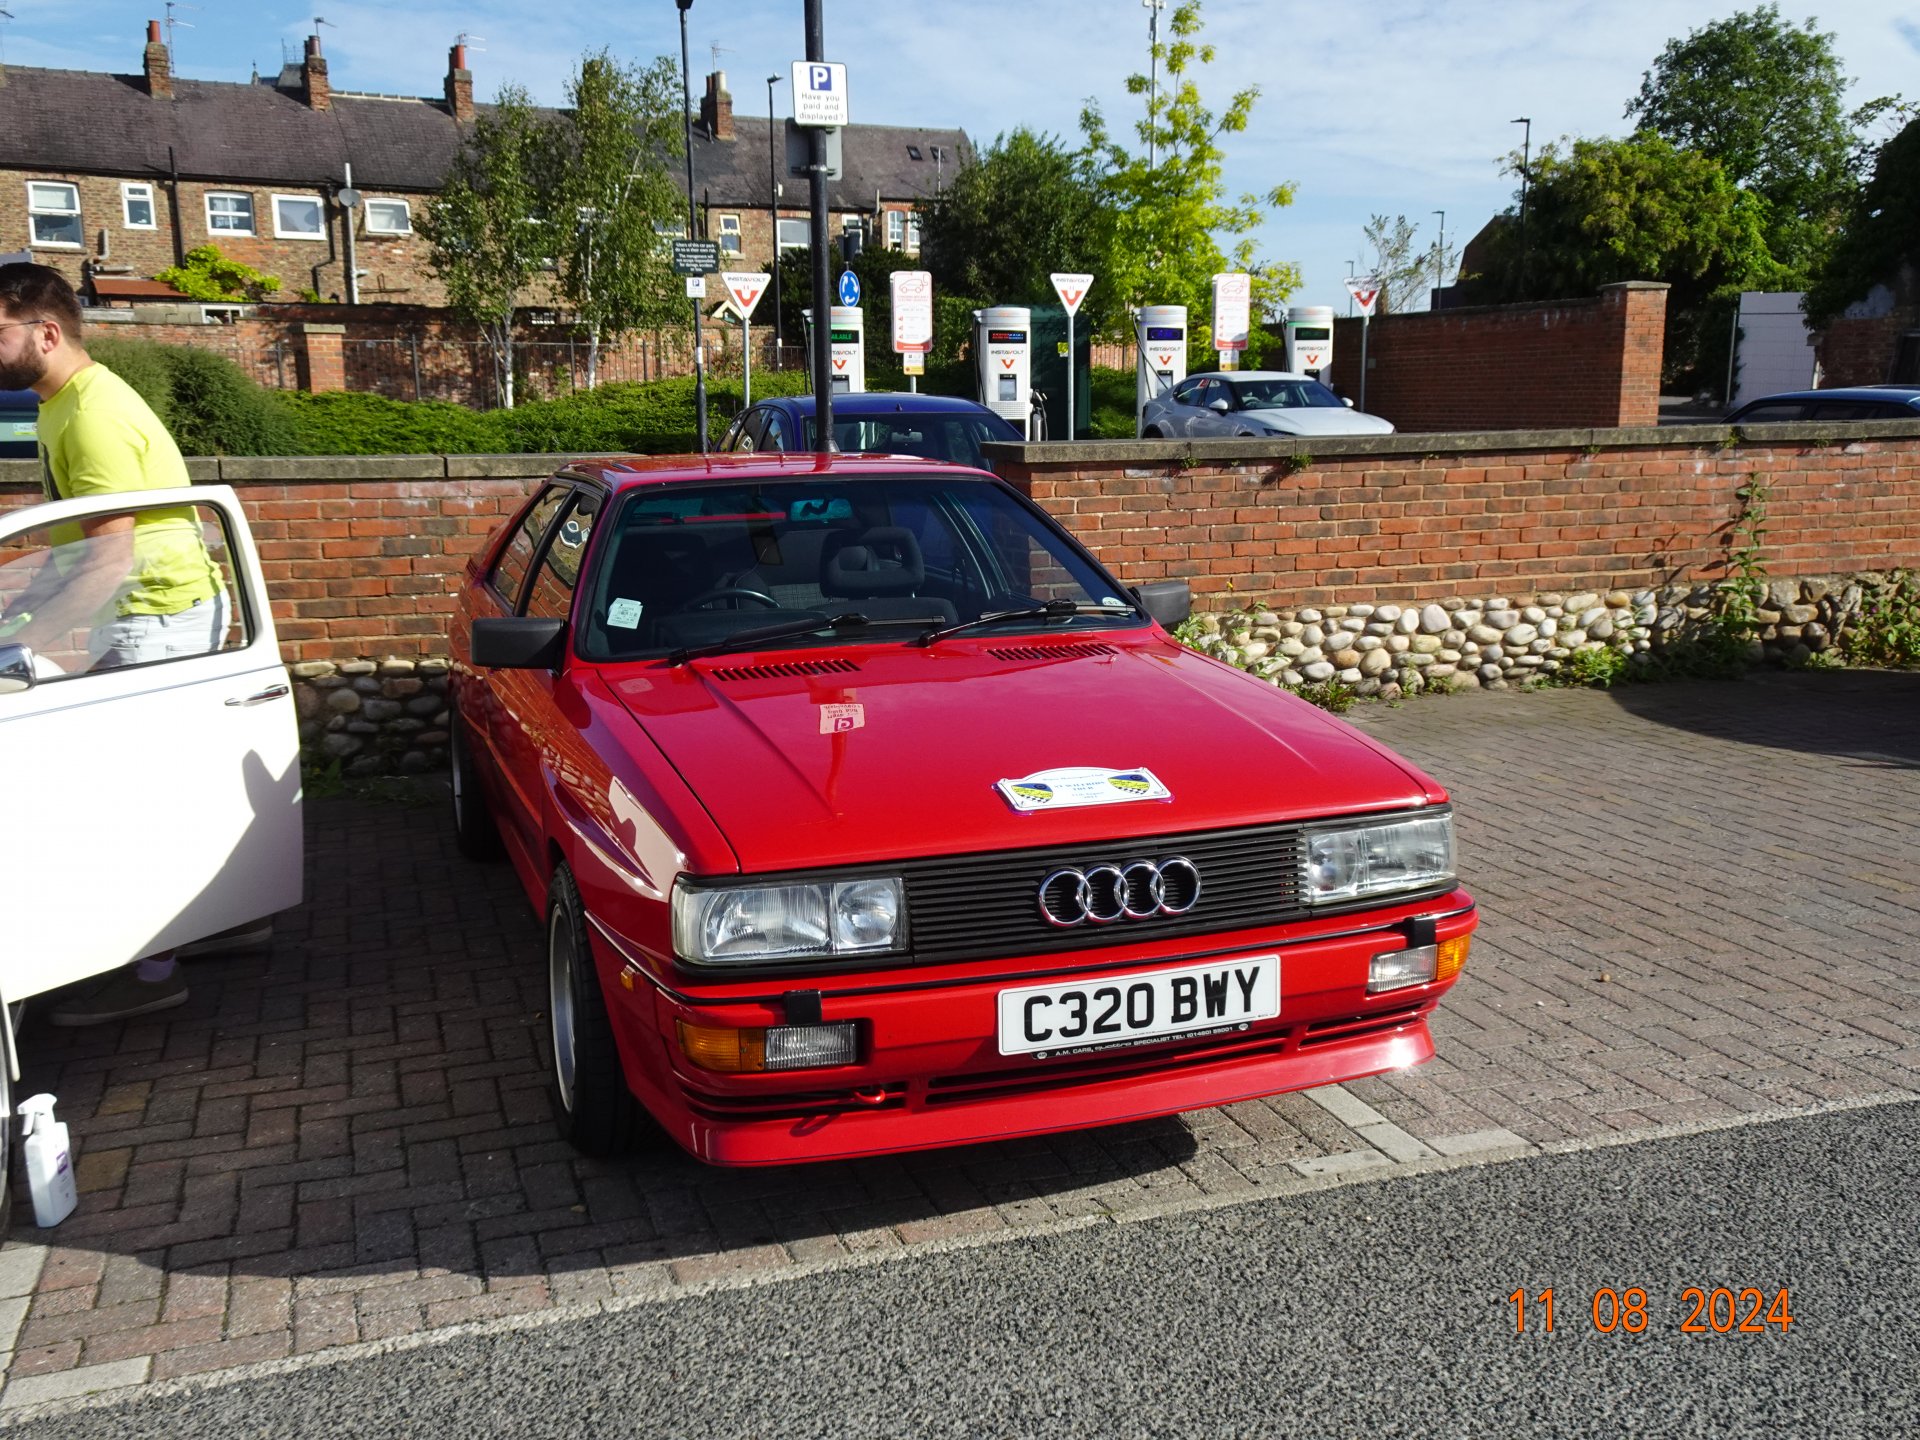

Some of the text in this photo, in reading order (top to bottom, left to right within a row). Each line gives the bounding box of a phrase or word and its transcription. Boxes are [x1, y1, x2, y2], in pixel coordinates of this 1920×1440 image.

[813, 67, 828, 89] P
[801, 92, 821, 100] Have
[824, 103, 839, 111] and
[1024, 966, 1260, 1042] C320 BWY
[1134, 1036, 1170, 1046] SPECIALIST
